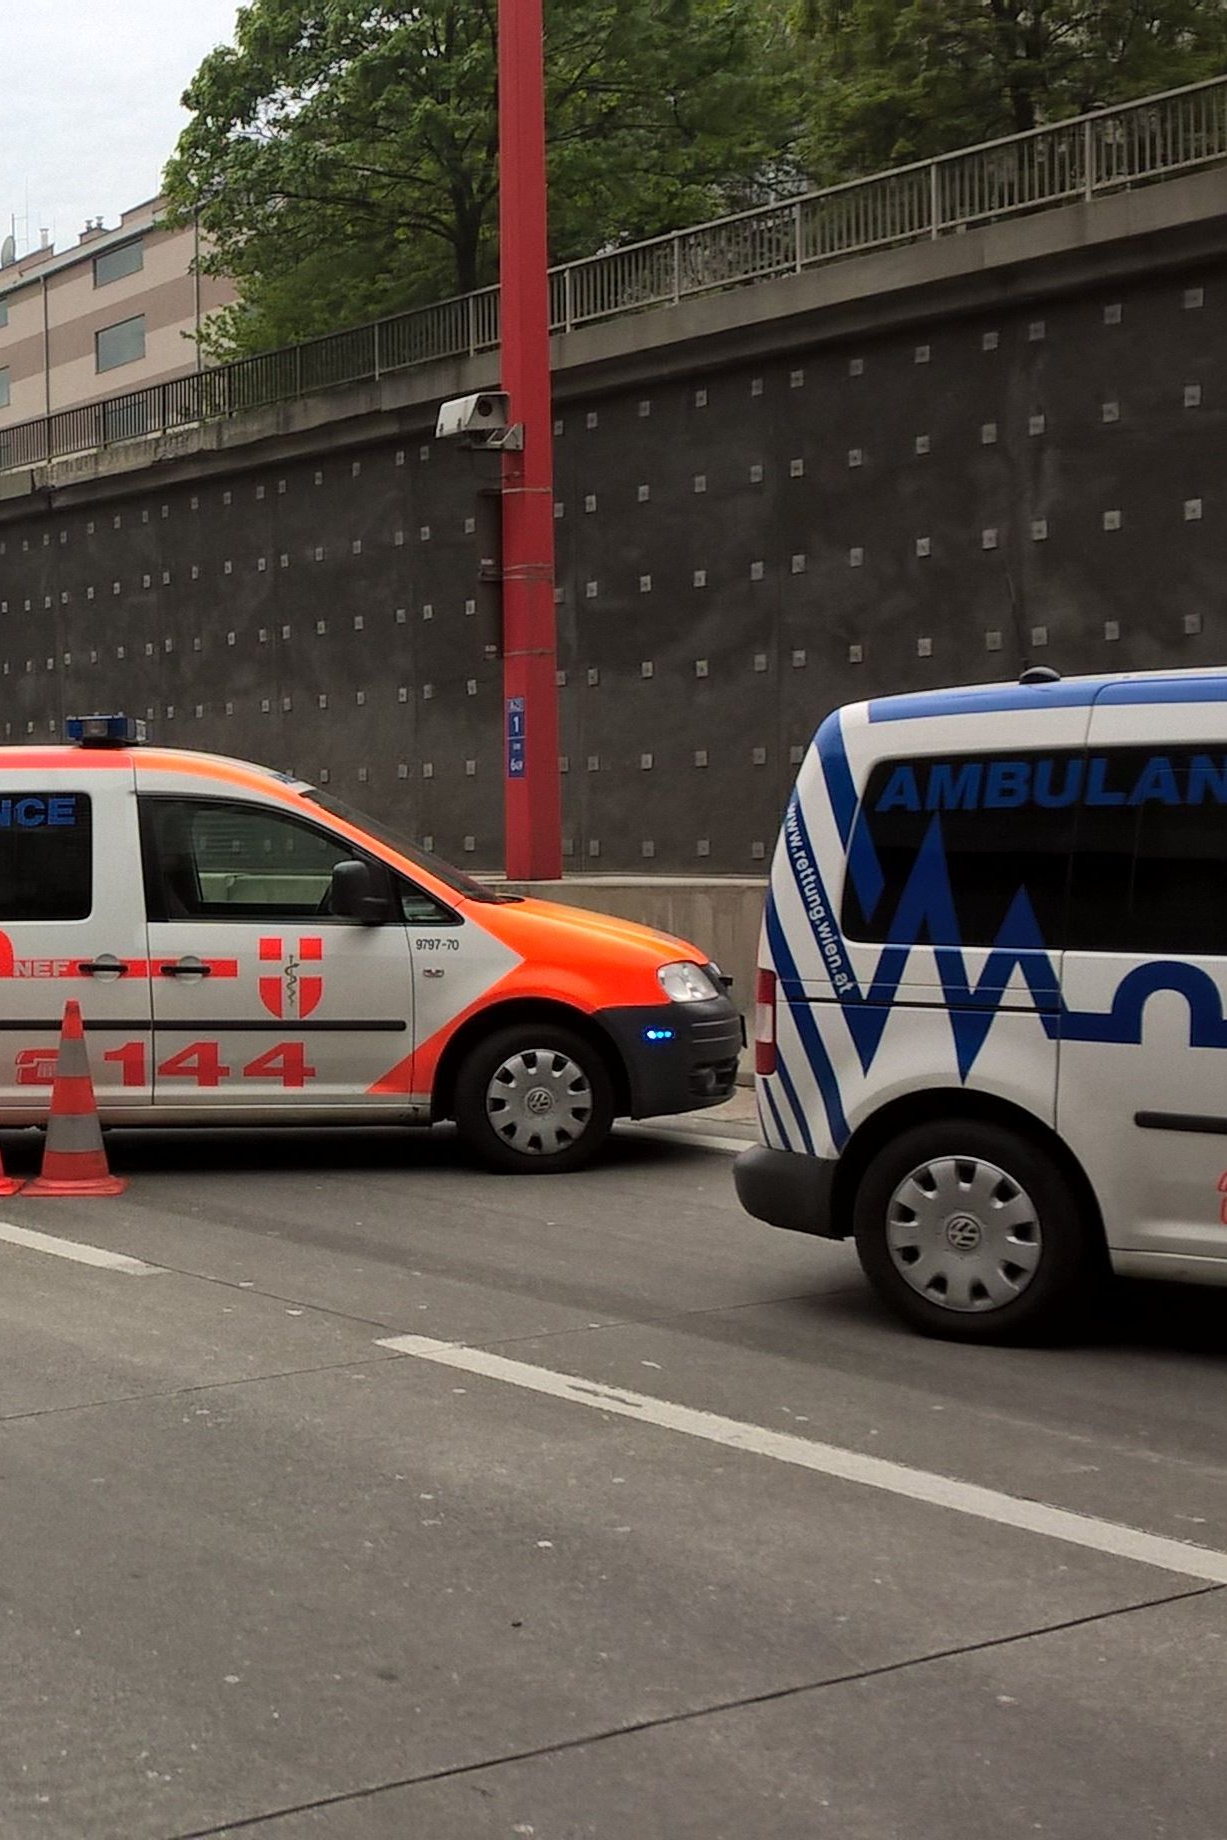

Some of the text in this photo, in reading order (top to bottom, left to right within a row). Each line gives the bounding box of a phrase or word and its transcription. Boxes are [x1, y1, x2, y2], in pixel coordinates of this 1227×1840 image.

[514, 716, 519, 733] 1
[875, 754, 1227, 812] AMBULAN
[784, 801, 857, 994] www.rettung.wien.at
[415, 938, 460, 951] 9797-70
[13, 960, 71, 978] NEF
[103, 1041, 317, 1088] 144
